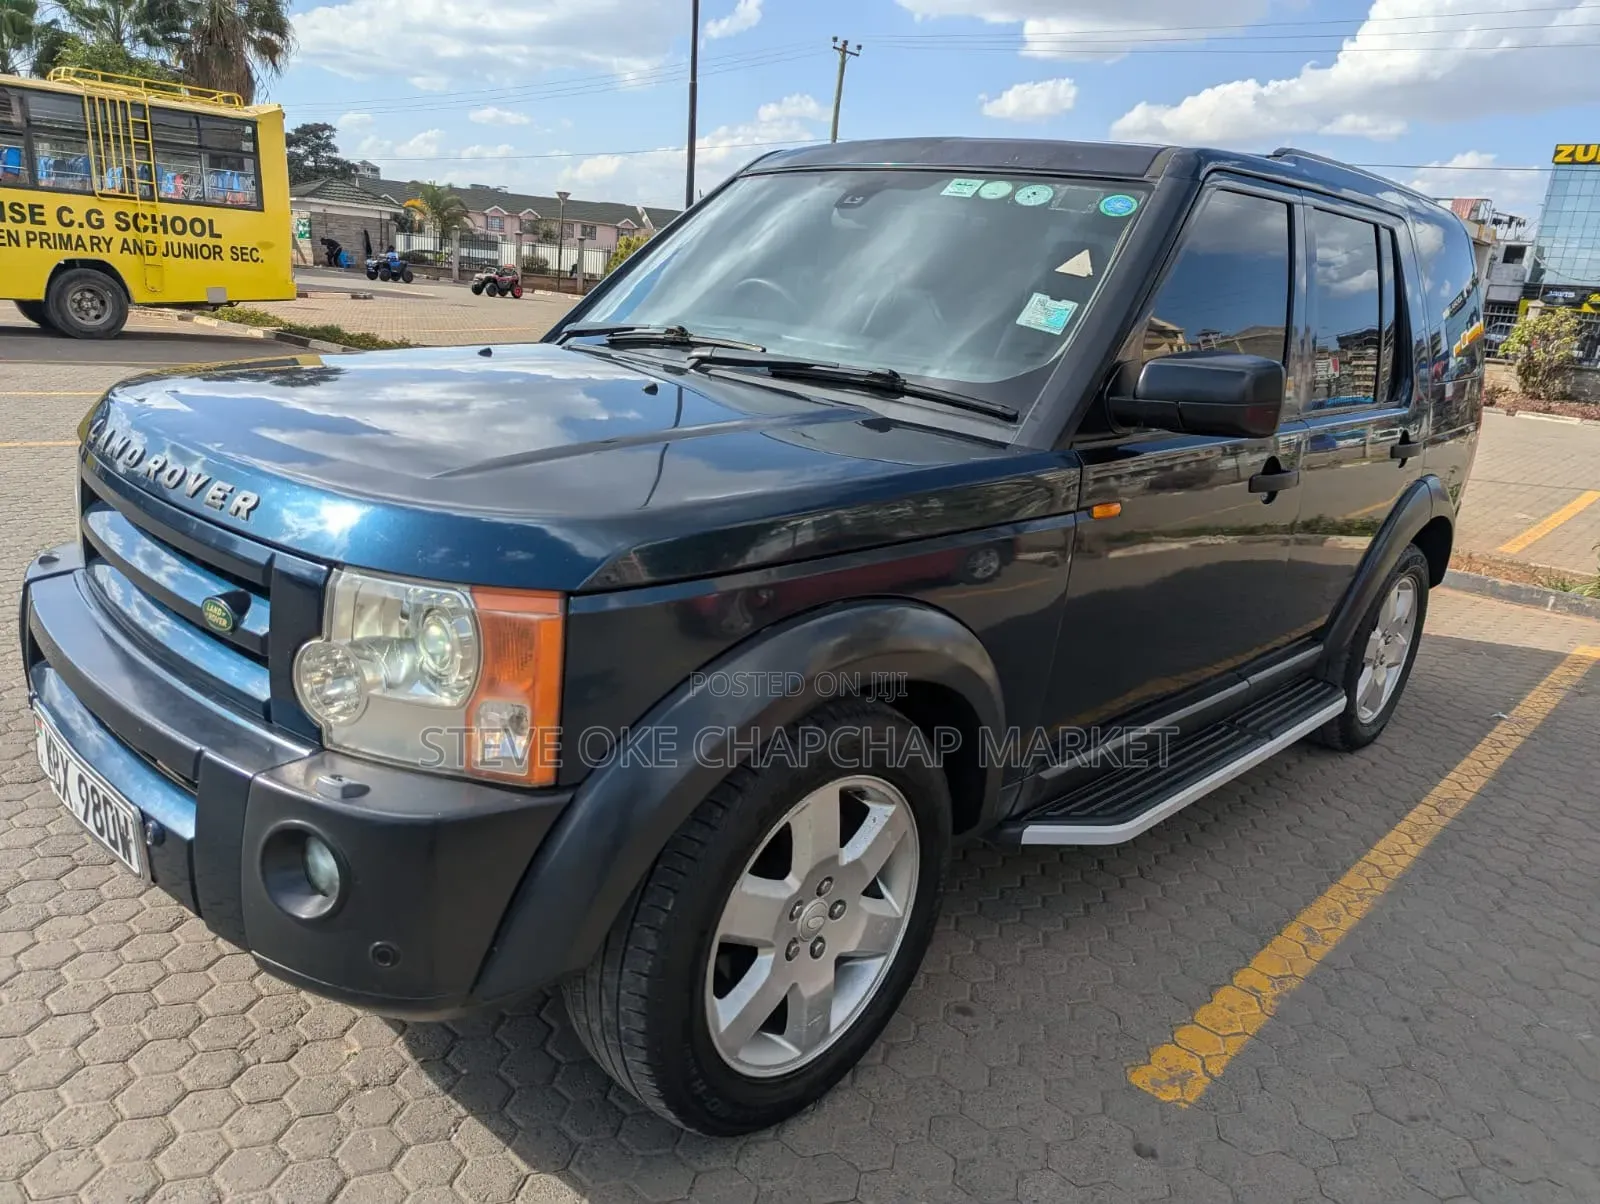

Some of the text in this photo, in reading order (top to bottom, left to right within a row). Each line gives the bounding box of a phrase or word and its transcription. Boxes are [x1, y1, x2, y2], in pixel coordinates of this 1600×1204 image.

[1554, 144, 1600, 162] ZU
[56, 206, 105, 230] C.G
[114, 211, 222, 239] SCHOOL
[26, 231, 113, 254] PRIMARY
[120, 238, 157, 257] AND
[162, 241, 224, 261] JUNIOR
[230, 246, 264, 264] SEC.
[146, 454, 260, 521] ROVER
